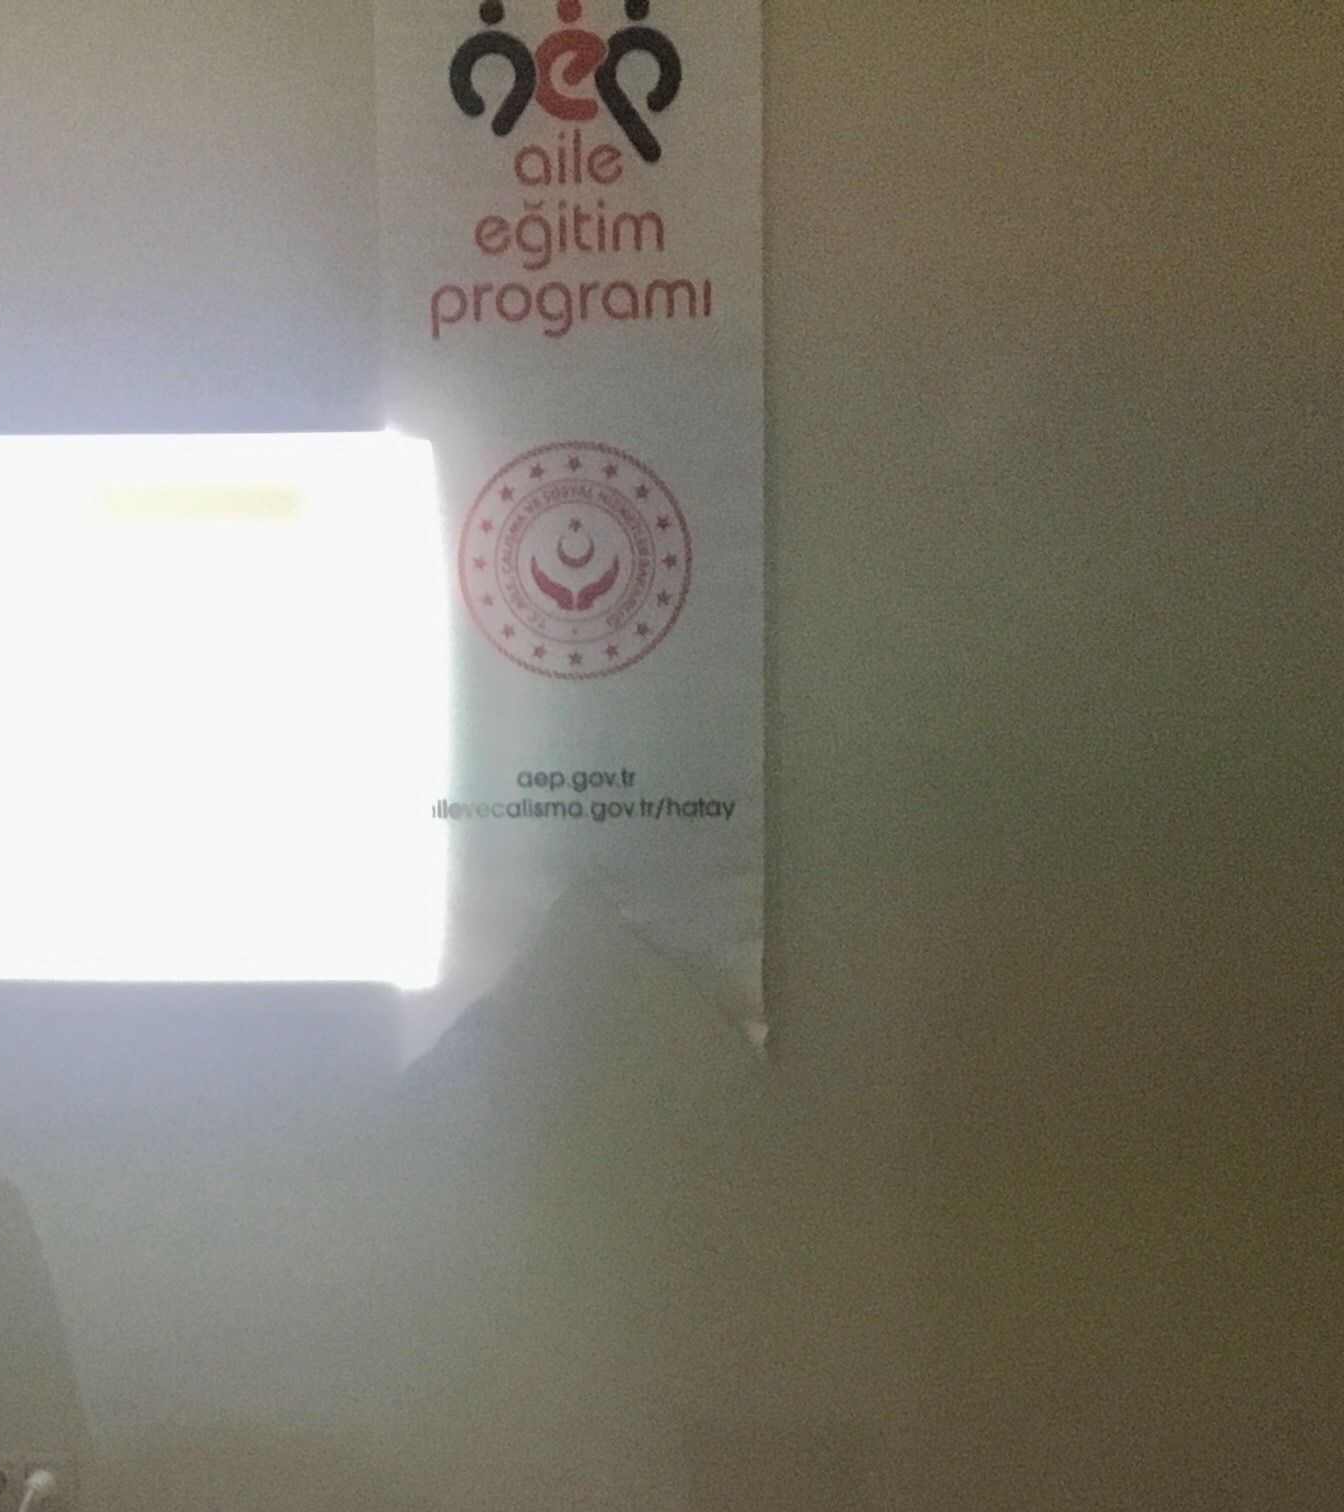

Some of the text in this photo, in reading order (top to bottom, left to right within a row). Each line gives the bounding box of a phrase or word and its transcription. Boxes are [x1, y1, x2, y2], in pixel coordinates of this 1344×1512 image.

[513, 128, 624, 186] aile
[474, 199, 665, 270] eğitim
[429, 278, 712, 339] programı
[516, 767, 636, 793] aep.gov.tr
